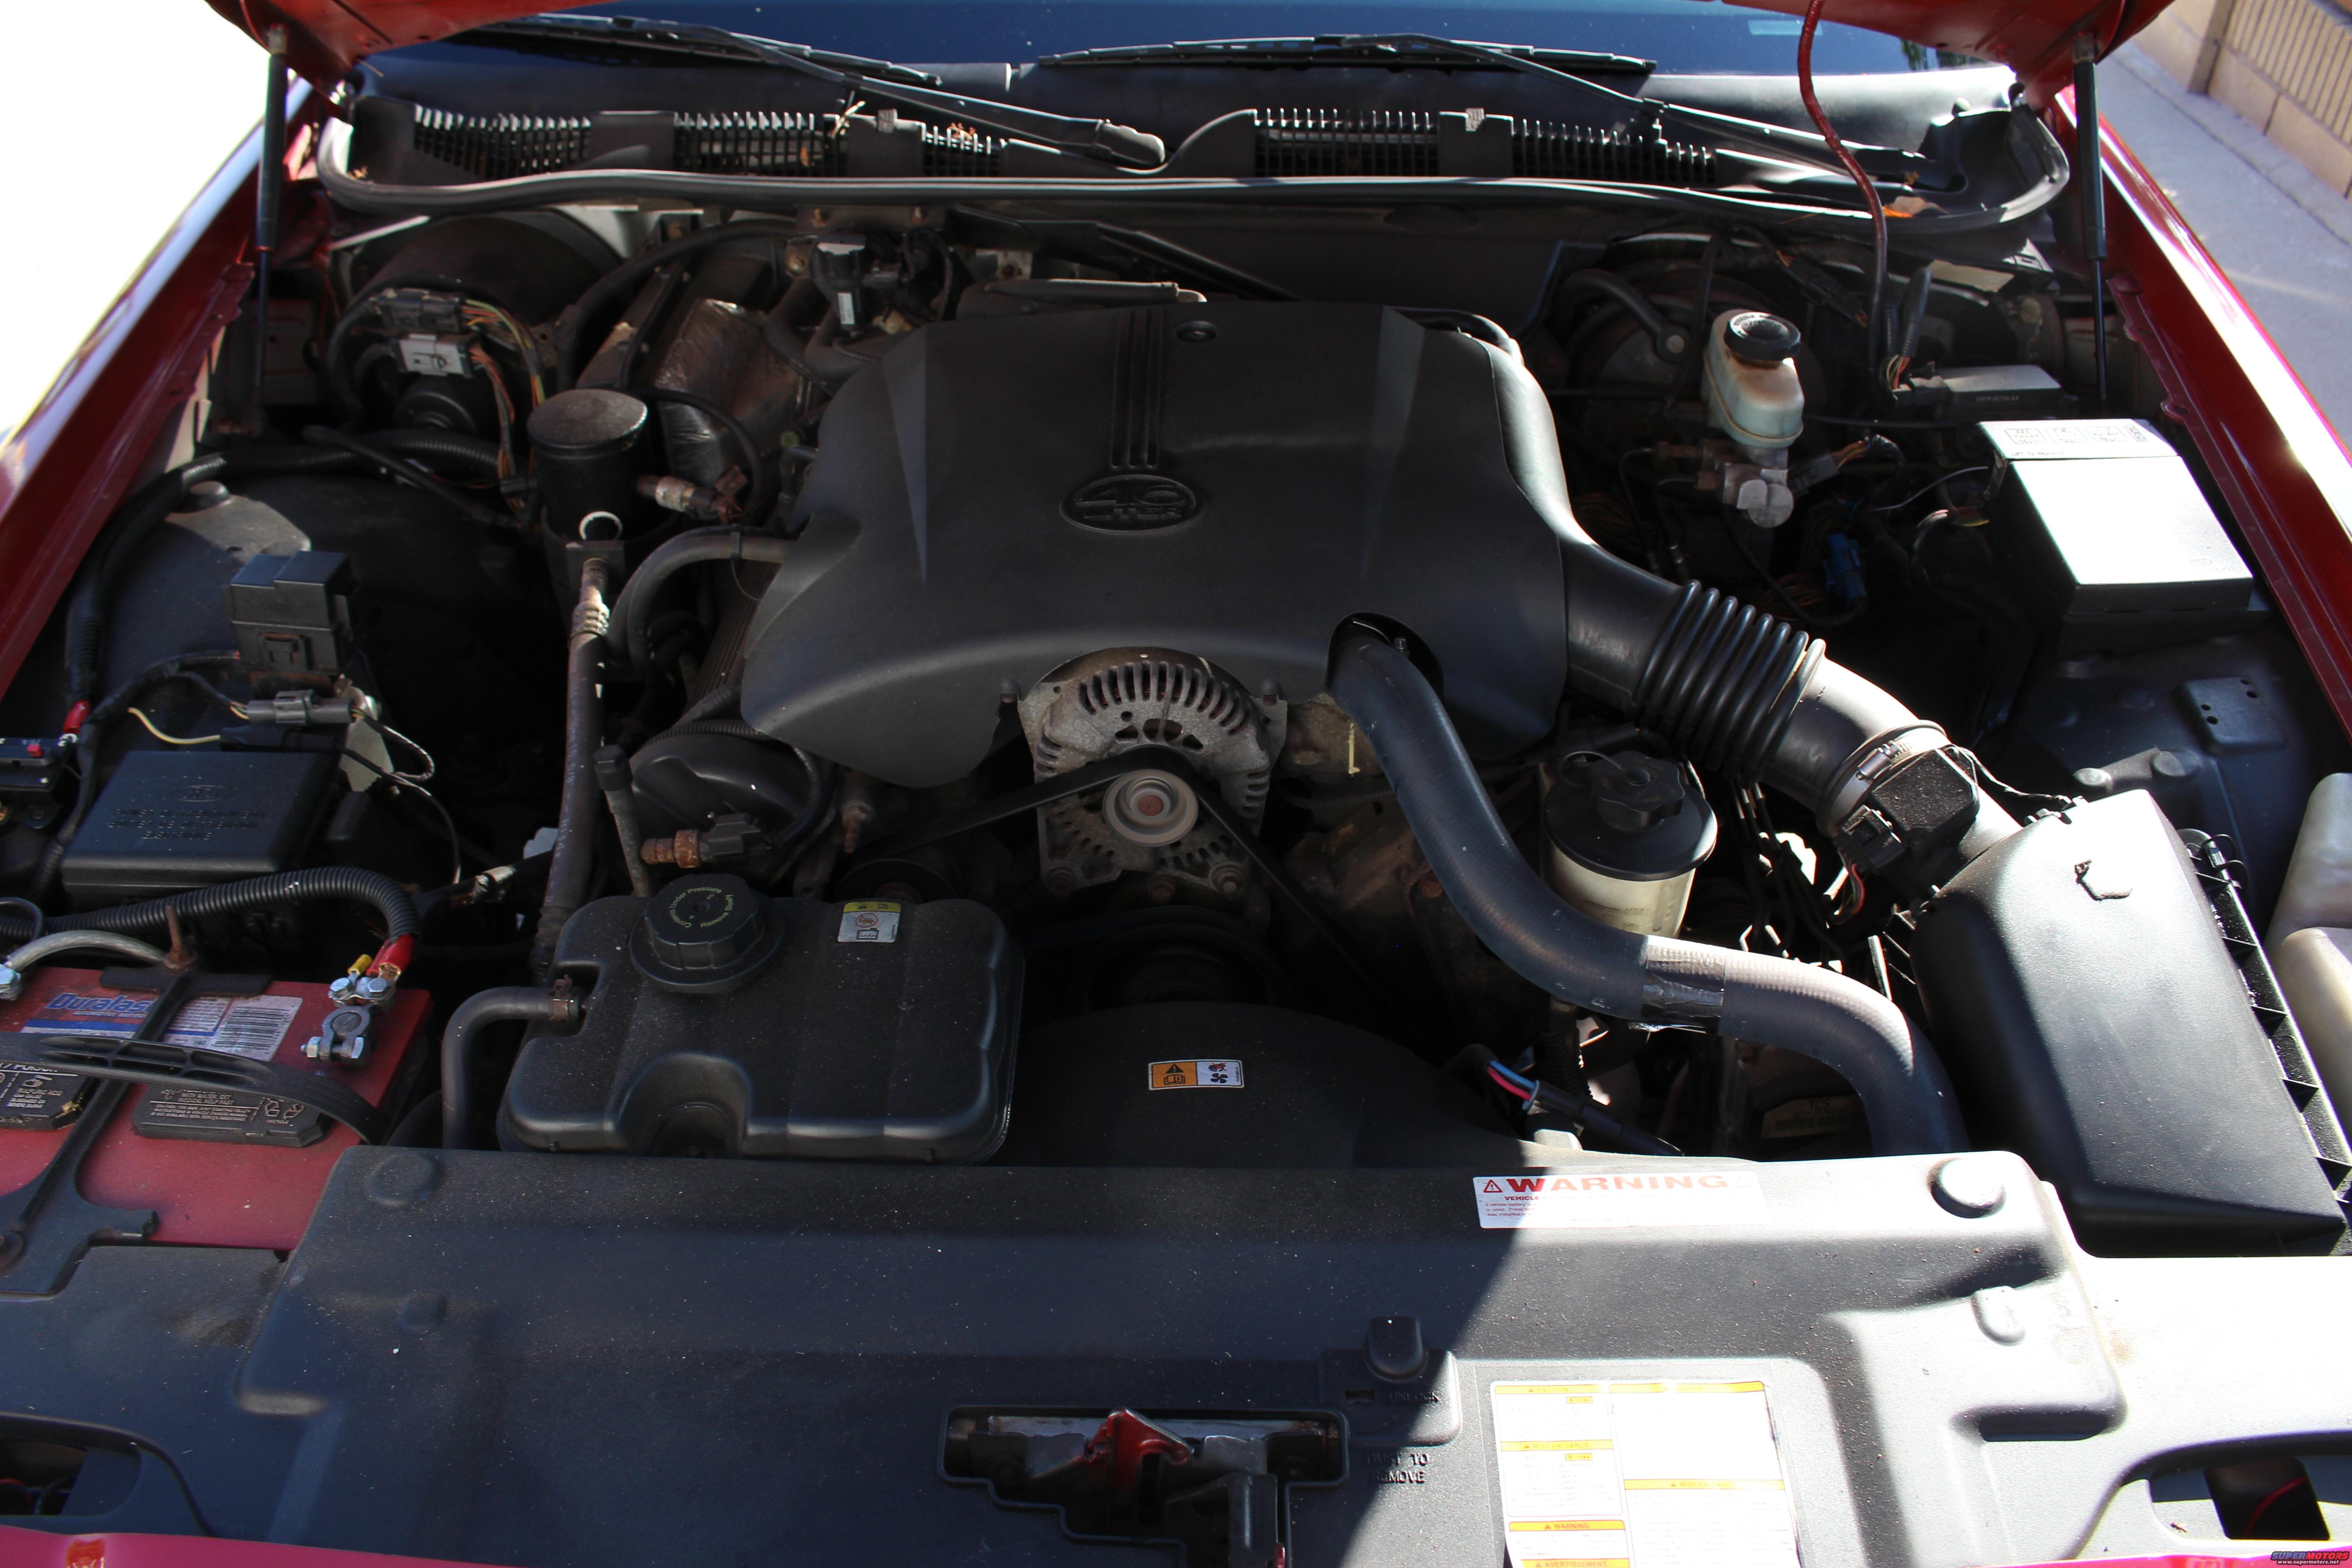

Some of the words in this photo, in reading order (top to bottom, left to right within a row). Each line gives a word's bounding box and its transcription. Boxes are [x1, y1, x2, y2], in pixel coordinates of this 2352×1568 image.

[669, 892, 687, 908] Under
[669, 909, 692, 928] Contents
[700, 911, 730, 928] Remove
[44, 992, 155, 1014] Duralas
[1506, 1176, 1728, 1192] WARNING
[1410, 1453, 1430, 1466] TO
[1372, 1470, 1426, 1483] REMOVE
